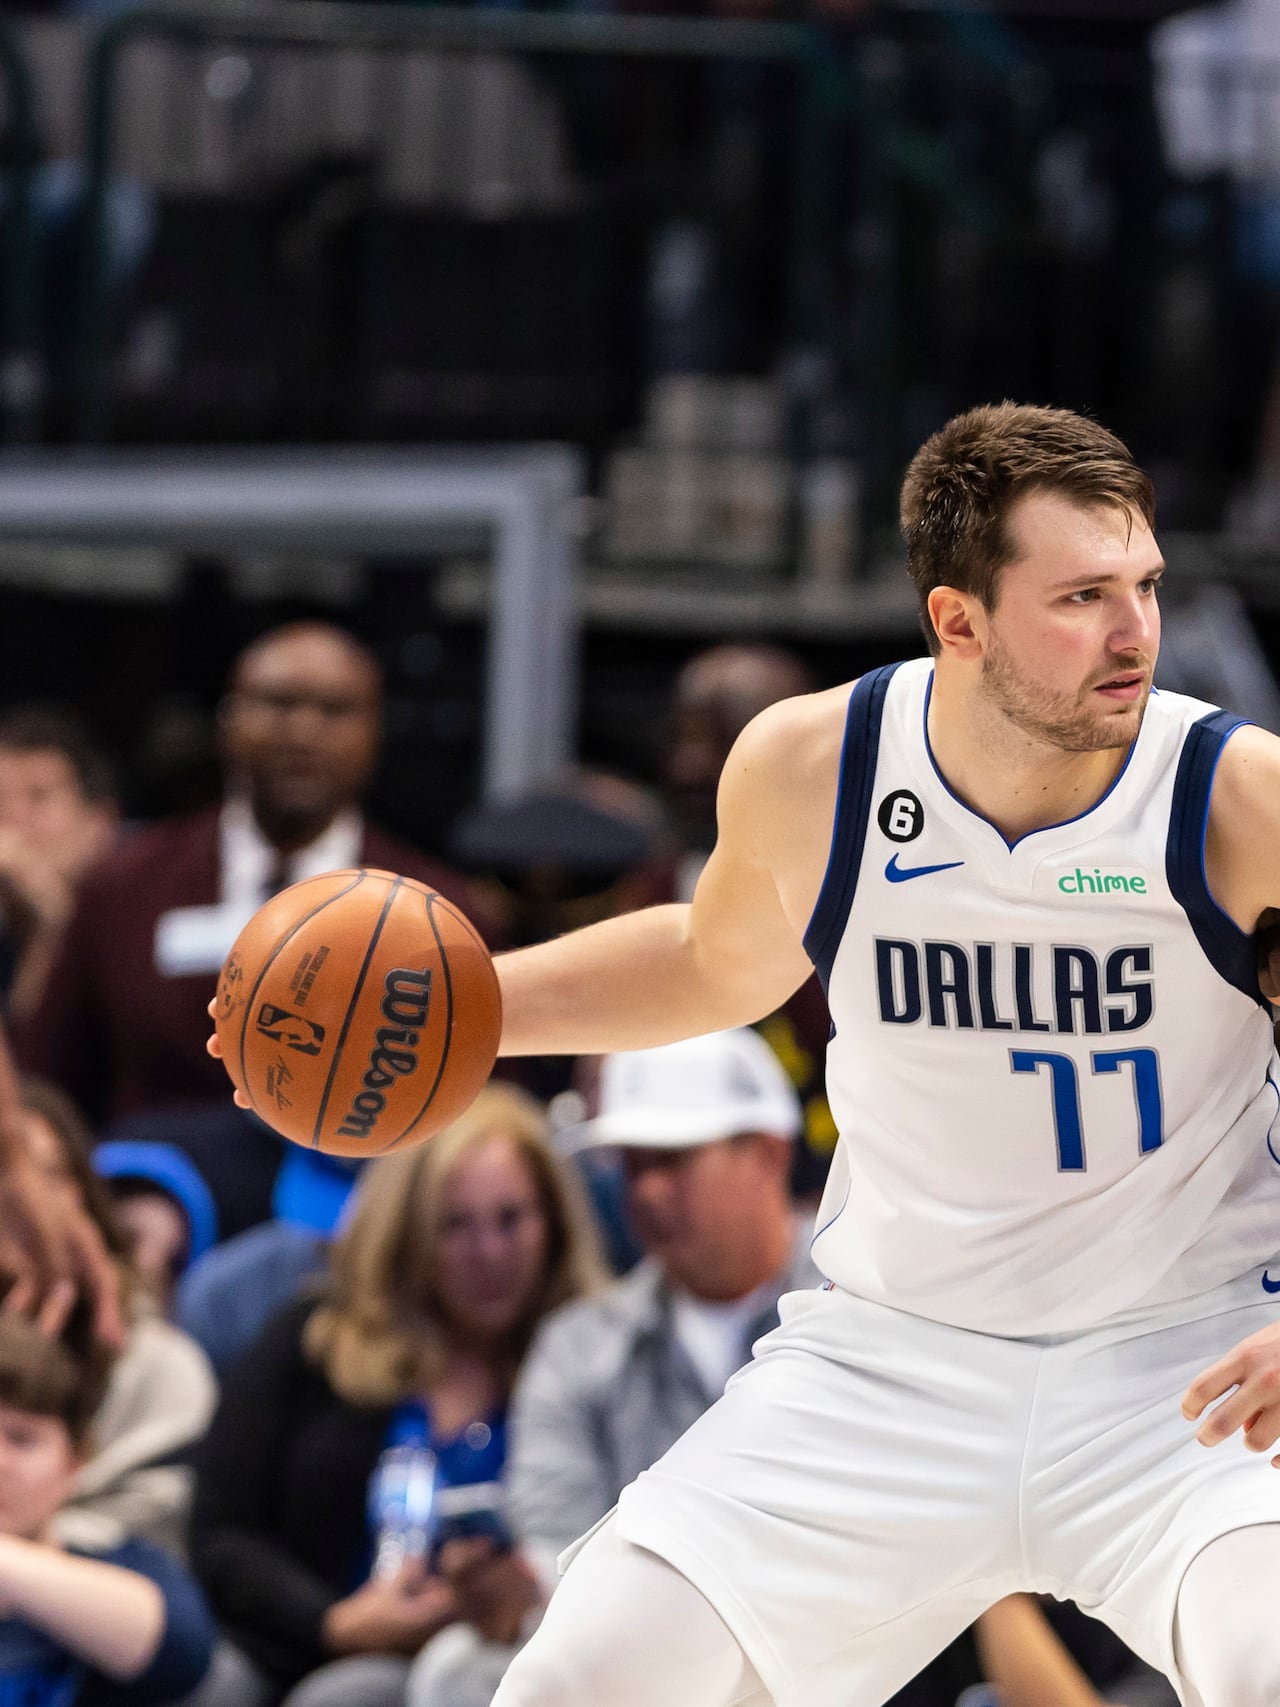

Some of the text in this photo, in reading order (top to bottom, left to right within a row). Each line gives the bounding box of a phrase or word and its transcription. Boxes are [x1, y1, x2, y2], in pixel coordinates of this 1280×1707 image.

[887, 796, 916, 838] 6
[1057, 868, 1148, 895] chime
[872, 934, 1157, 1037] DALLAS
[335, 967, 432, 1139] Wilson
[1007, 1046, 1166, 1173] 77
